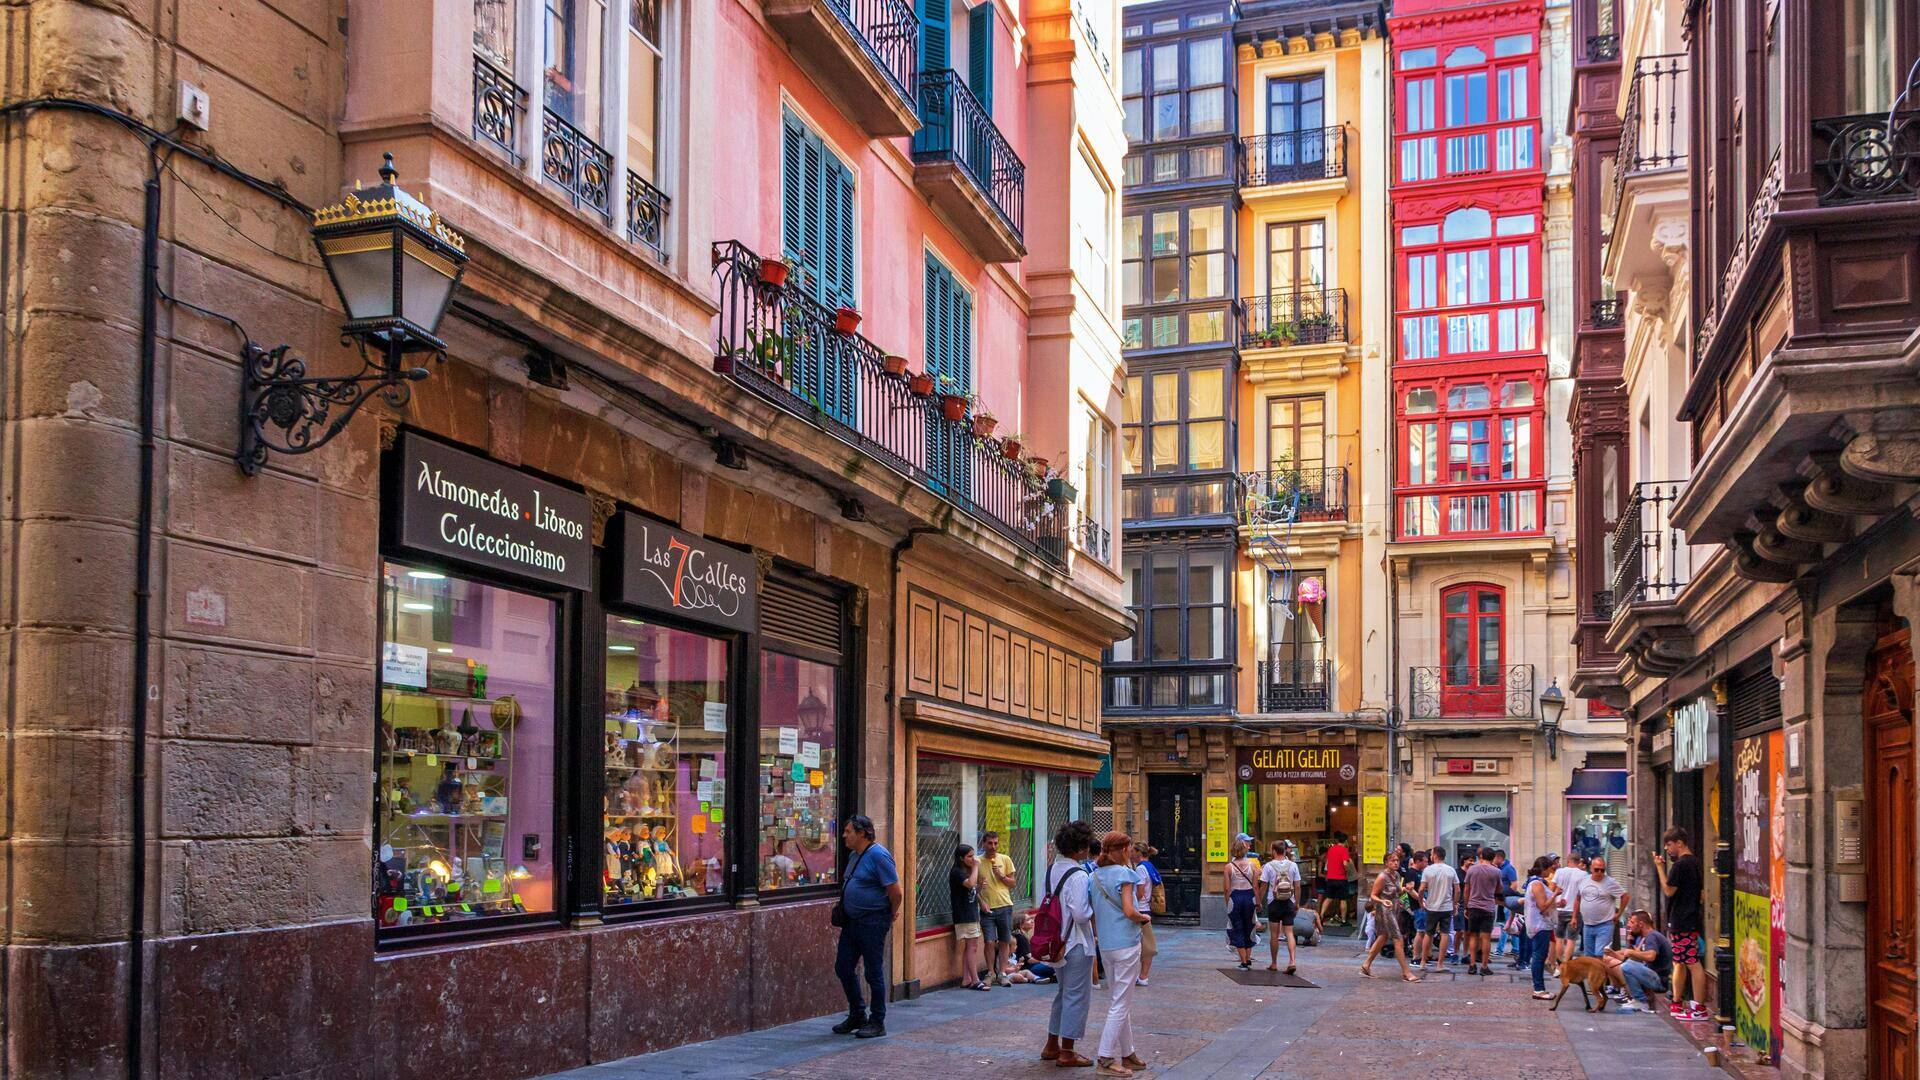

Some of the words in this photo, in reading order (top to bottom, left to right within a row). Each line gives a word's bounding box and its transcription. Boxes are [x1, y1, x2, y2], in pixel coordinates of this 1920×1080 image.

[417, 460, 520, 521] Almonedas
[533, 489, 584, 541] Libros
[440, 512, 566, 573] Coleccionismo
[641, 525, 671, 568] Las
[667, 536, 690, 606] 7
[688, 550, 747, 595] Calles
[1253, 749, 1295, 769] GELATI
[1298, 749, 1340, 769] GELATI
[1266, 771, 1283, 779] GELATO
[1448, 804, 1469, 813] ATM
[1473, 804, 1502, 814] Cajero
